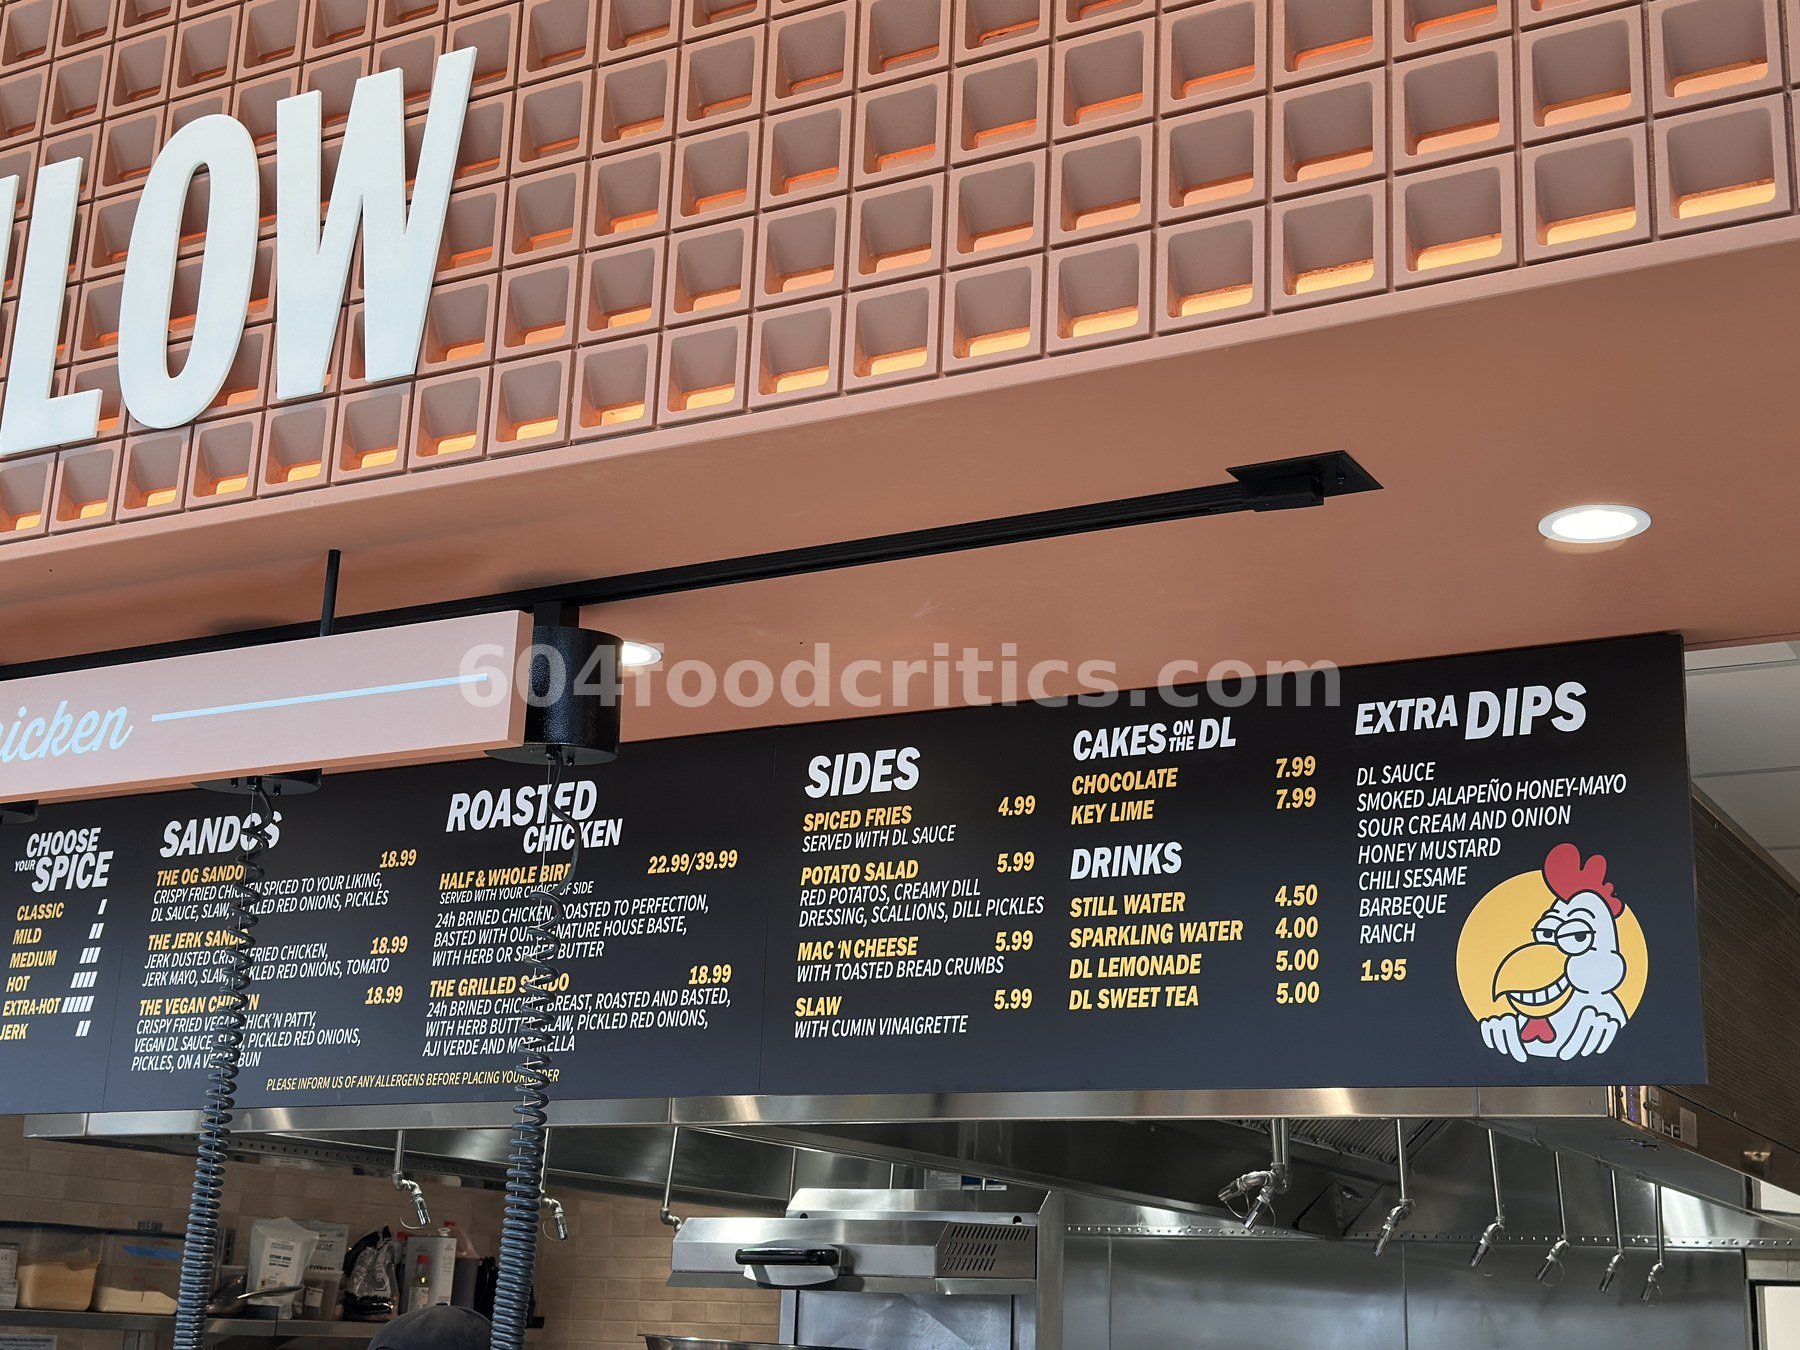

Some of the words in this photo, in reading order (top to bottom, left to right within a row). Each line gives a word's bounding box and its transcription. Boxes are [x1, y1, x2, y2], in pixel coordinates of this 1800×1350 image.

[0, 46, 478, 457] LOW
[1354, 695, 1458, 736] EXTRA
[1464, 681, 1587, 740] DIPS
[1173, 720, 1194, 735] ON
[1198, 716, 1237, 750] DL
[1072, 723, 1167, 761] CAKES
[1169, 736, 1195, 753] THE
[804, 747, 921, 799] SIDES
[1071, 767, 1179, 795] CHOCOLATE
[1275, 755, 1316, 779] 7.99
[1357, 767, 1376, 786] DL
[1382, 762, 1435, 784] SAUCE
[446, 780, 597, 832] ROASTED
[1071, 804, 1107, 824] KEY
[1110, 800, 1154, 822] LIME
[1275, 786, 1317, 810] 7.99
[1357, 790, 1424, 812] SMOKED
[1427, 779, 1512, 806] JALAPEÑO
[1516, 774, 1626, 800] HONEY-MAYO
[803, 810, 861, 832] SPICED
[865, 806, 912, 826] FRIES
[998, 794, 1036, 817] 4.99
[1358, 817, 1404, 838] SOUR
[1409, 812, 1466, 834] CREAM
[1469, 810, 1506, 830] AND
[1512, 805, 1570, 827] ONION
[27, 827, 101, 858] CHOOSE
[802, 833, 852, 852] SERVED
[856, 830, 889, 848] WITH
[892, 828, 908, 845] DL
[912, 825, 956, 844] SAUCE
[1358, 842, 1417, 864] HONEY
[1420, 838, 1500, 860] MUSTARD
[15, 860, 36, 872] YOUR
[32, 850, 114, 893] SPICE
[157, 870, 180, 886] THE
[182, 868, 199, 884] OG
[201, 865, 244, 883] SANDO
[380, 849, 416, 869] 18.99
[801, 864, 860, 885] POTATO
[864, 860, 918, 881] SALAD
[996, 851, 1035, 873] 5.99
[1070, 842, 1183, 880] DRINKS
[154, 888, 188, 904] CRISPY
[188, 885, 217, 901] FRIED
[262, 880, 298, 896] SPICED
[302, 878, 314, 892] TO
[317, 876, 344, 891] YOUR
[439, 871, 475, 890] HALF
[476, 870, 485, 887] &
[489, 866, 537, 886] WHOLE
[1359, 870, 1400, 890] CHILI
[1403, 866, 1467, 888] SESAME
[440, 891, 472, 904] SERVED
[474, 888, 497, 902] WITH
[572, 881, 594, 894] SIDE
[800, 889, 826, 906] RED
[895, 880, 950, 900] CREAMY
[952, 879, 980, 897] DILL
[1070, 896, 1117, 917] STILL
[1124, 892, 1185, 914] WATER
[1274, 884, 1318, 907] 4.50
[1359, 894, 1447, 918] BARBEQUE
[17, 902, 64, 921] CLASSIC
[435, 911, 455, 928] 24h
[458, 909, 499, 926] BRINED
[614, 900, 629, 916] TO
[953, 900, 982, 918] DILL
[986, 896, 1044, 916] PICKLES
[13, 928, 42, 945] MILD
[148, 934, 171, 950] THE
[172, 932, 204, 949] JERK
[370, 936, 408, 955] 18.99
[434, 930, 476, 947] BASTED
[479, 928, 508, 944] WITH
[603, 918, 645, 936] HOUSE
[798, 941, 834, 961] MAC
[854, 936, 918, 958] CHEESE
[994, 930, 1034, 952] 5.99
[1070, 923, 1173, 948] SPARKLING
[1180, 920, 1243, 942] WATER
[1274, 916, 1319, 939] 4.00
[1359, 923, 1416, 944] RANCH
[9, 950, 57, 968] MEDIUM
[144, 953, 171, 969] JERK
[171, 950, 211, 967] DUSTED
[250, 946, 278, 962] FRIED
[432, 950, 461, 966] WITH
[463, 948, 494, 964] HERB
[496, 947, 512, 962] OR
[558, 941, 604, 959] BUTTER
[1070, 959, 1092, 978] DL
[1098, 954, 1202, 978] LEMONADE
[1275, 948, 1320, 972] 5.00
[430, 980, 456, 997] THE
[458, 976, 516, 996] GRILLED
[688, 964, 732, 985] 18.99
[798, 964, 831, 982] WITH
[835, 962, 893, 980] TOASTED
[896, 959, 941, 978] BREAD
[945, 956, 1004, 975] CRUMBS
[1360, 958, 1407, 981] 1.95
[6, 976, 30, 992] HOT
[1069, 990, 1092, 1010] DL
[1097, 987, 1161, 1009] SWEET
[1165, 986, 1198, 1006] TEA
[1275, 981, 1320, 1005] 5.00
[2, 998, 61, 1016] EXTRA-HOT
[140, 999, 163, 1016] THE
[166, 996, 207, 1014] VEGAN
[365, 986, 403, 1005] 18.99
[426, 1000, 447, 1017] 24h
[449, 999, 492, 1016] BRINED
[595, 991, 650, 1009] ROASTED
[651, 990, 678, 1006] AND
[794, 996, 842, 1017] SLAW
[993, 988, 1033, 1010] 5.99
[0, 1023, 28, 1040] JERK
[137, 1018, 173, 1034] CRISPY
[172, 1017, 202, 1032] FRIED
[795, 1020, 829, 1038] WITH
[832, 1018, 876, 1037] CUMIN
[880, 1015, 968, 1035] VINAIGRETTE
[422, 1041, 441, 1056] AJI
[444, 1039, 480, 1056] VERDE
[480, 1038, 505, 1054] AND
[266, 1078, 297, 1090] PLEASE
[298, 1077, 330, 1089] INFORM
[332, 1076, 344, 1088] US
[345, 1076, 357, 1088] OF
[357, 1075, 375, 1087] ANY
[375, 1074, 425, 1087] ALLERGENS
[426, 1072, 461, 1086] BEFORE
[462, 1071, 500, 1084] PLACING
